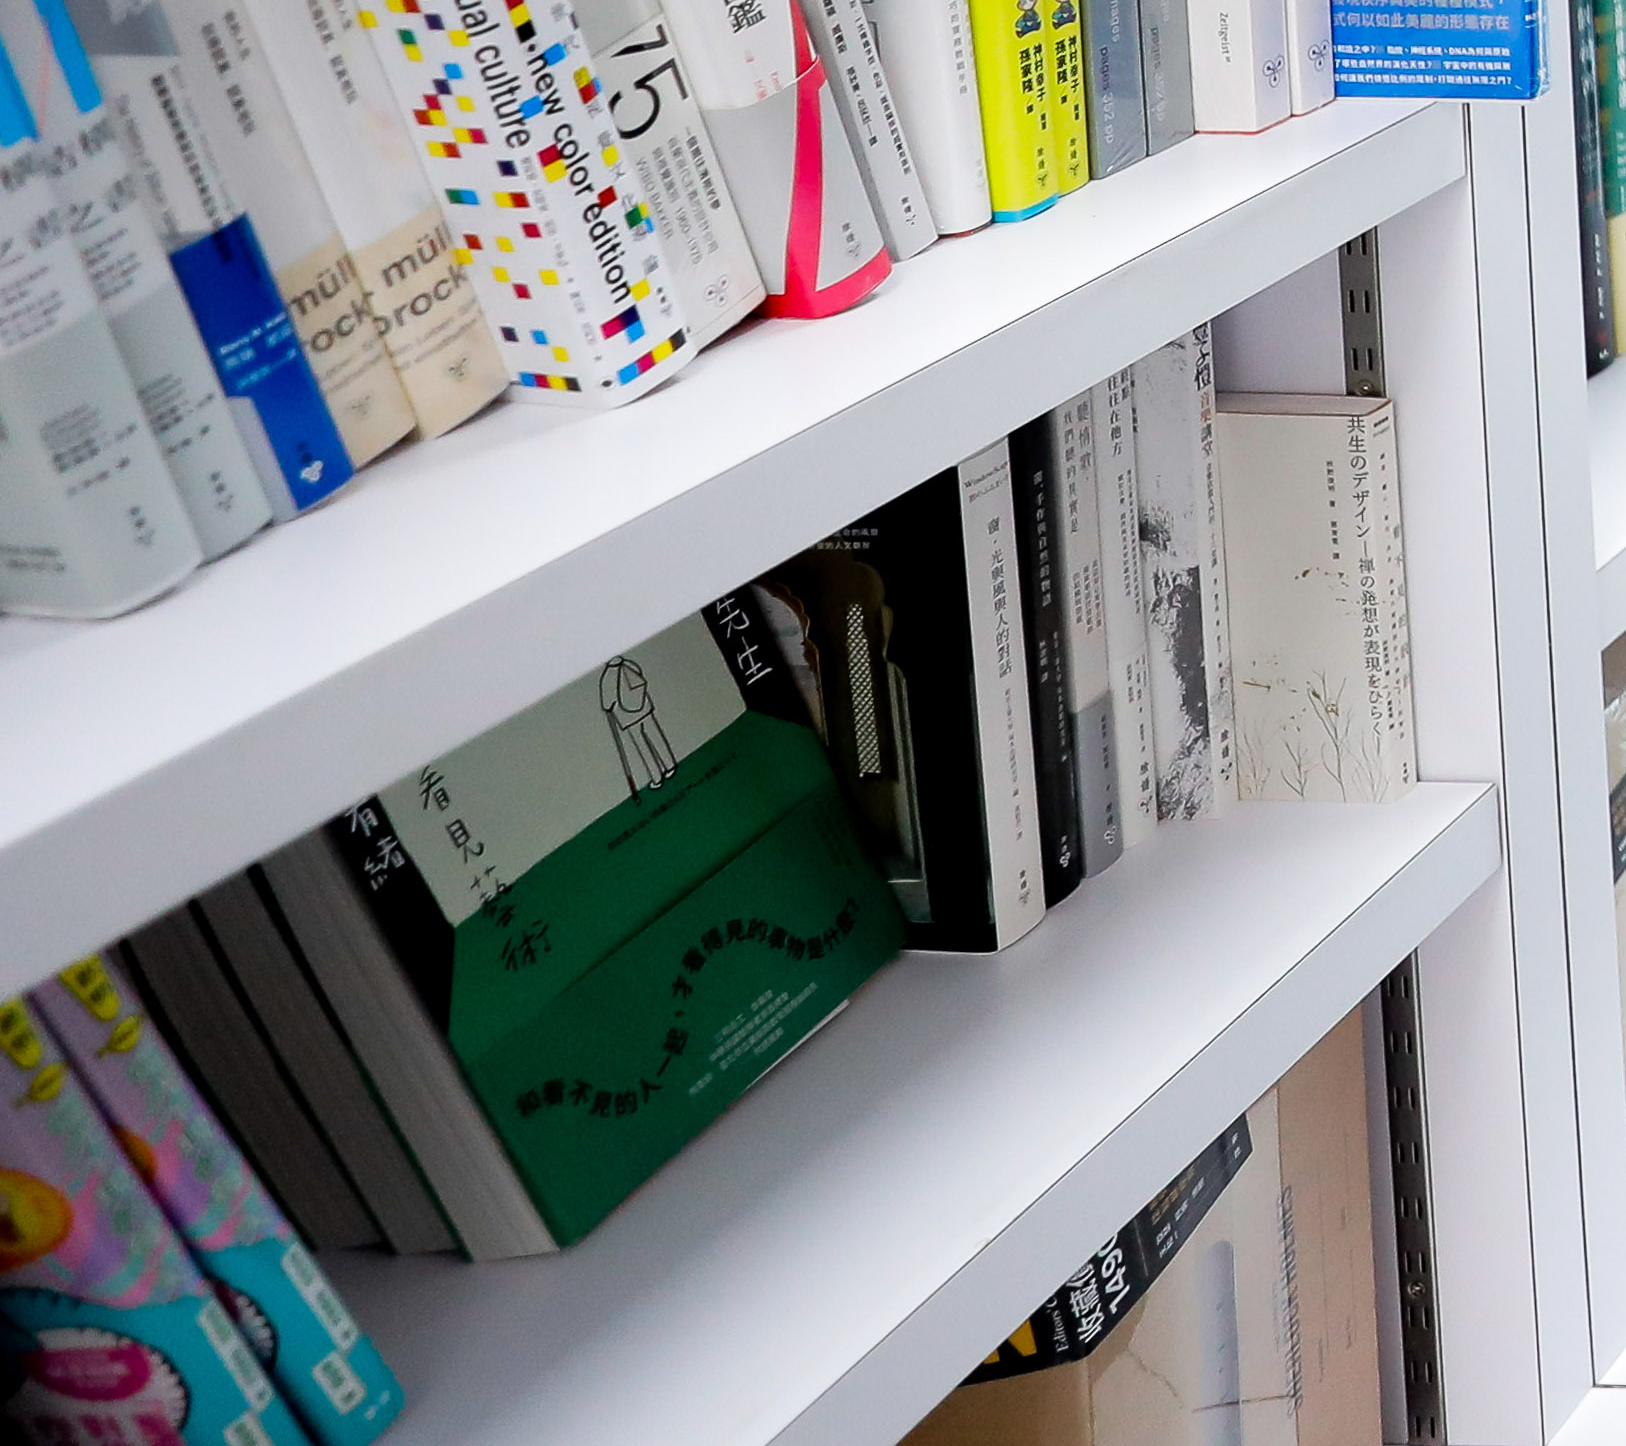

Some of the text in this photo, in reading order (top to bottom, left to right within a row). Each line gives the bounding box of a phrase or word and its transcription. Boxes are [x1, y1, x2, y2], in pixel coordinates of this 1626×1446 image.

[473, 44, 532, 151] culture
[527, 57, 635, 308] new color edition
[416, 759, 554, 975] 看見藝術
